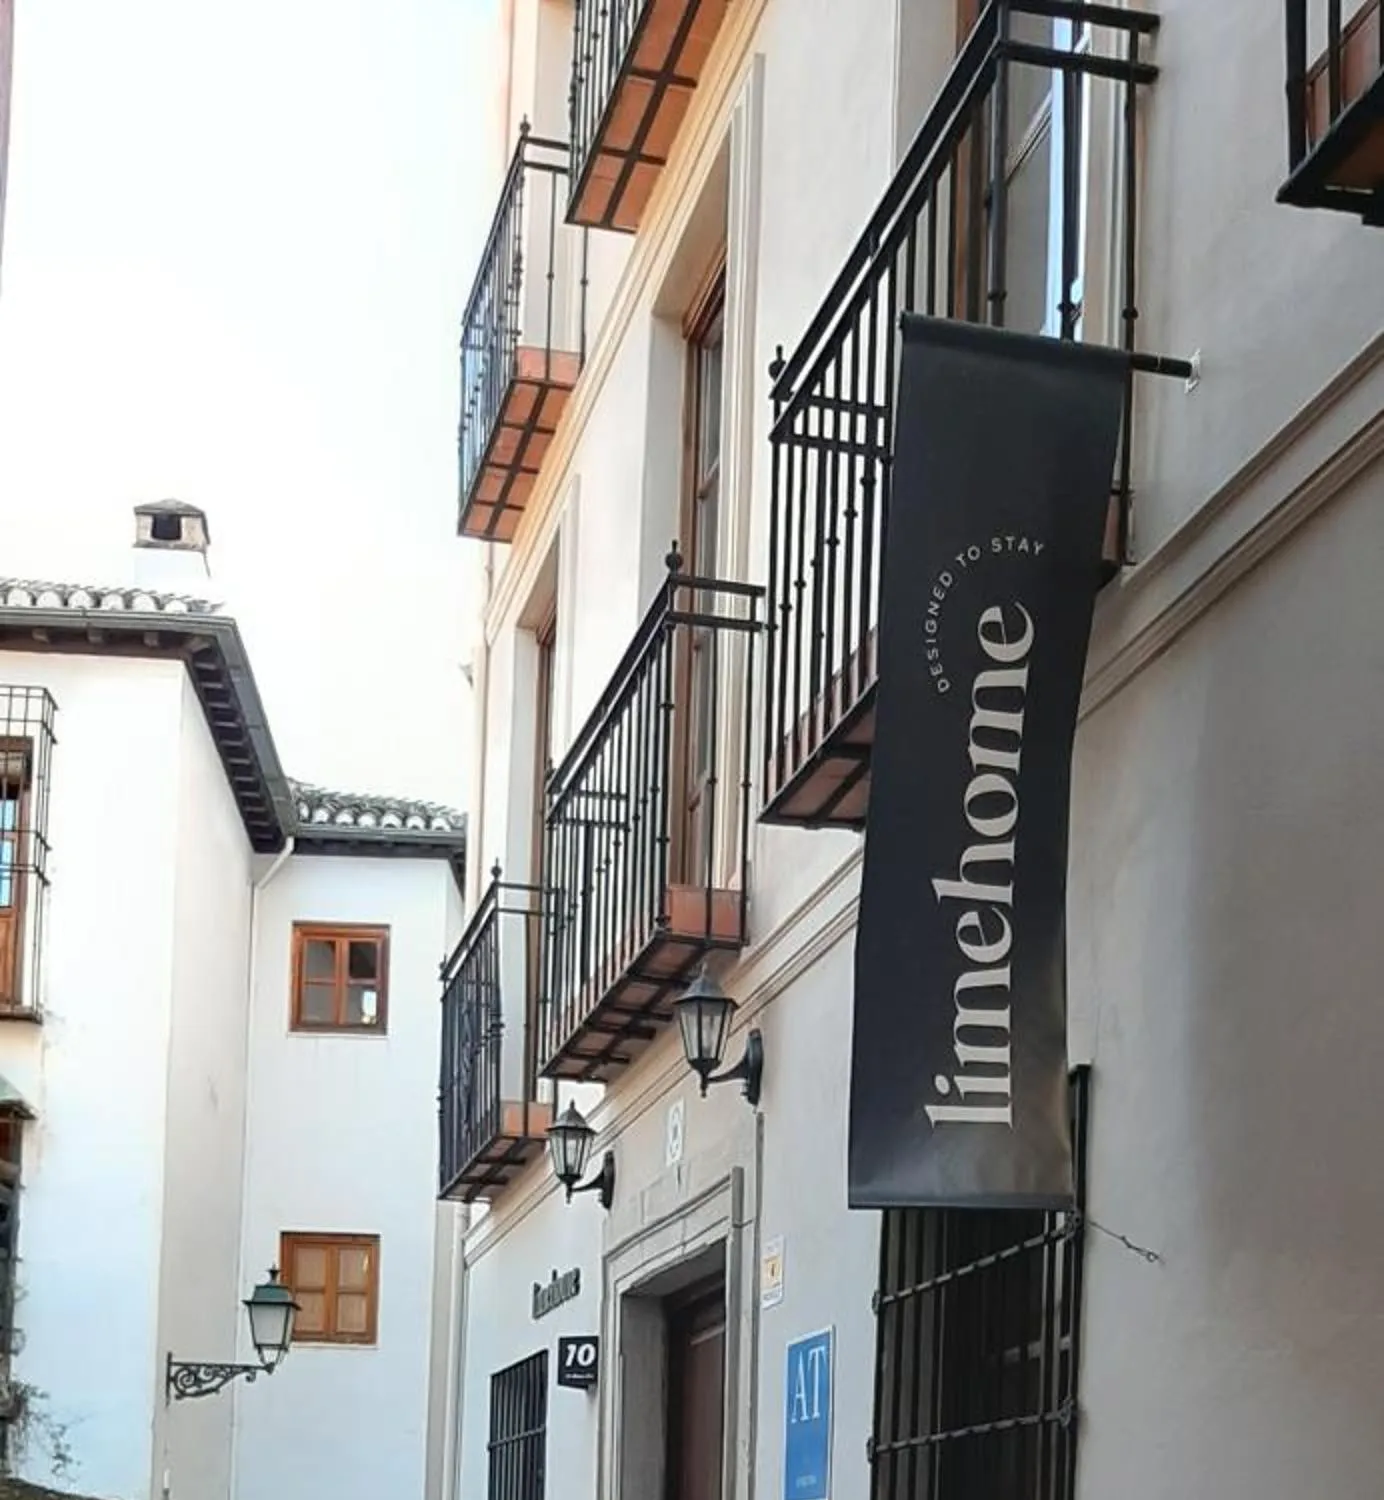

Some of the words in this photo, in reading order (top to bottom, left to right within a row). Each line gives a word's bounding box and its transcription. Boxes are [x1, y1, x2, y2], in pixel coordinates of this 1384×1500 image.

[925, 571, 953, 693] DESIGNED
[955, 545, 981, 568] TO
[991, 534, 1045, 556] STAY
[925, 601, 1035, 1130] limehome
[564, 1343, 596, 1367] 10
[790, 1345, 828, 1424] AT
